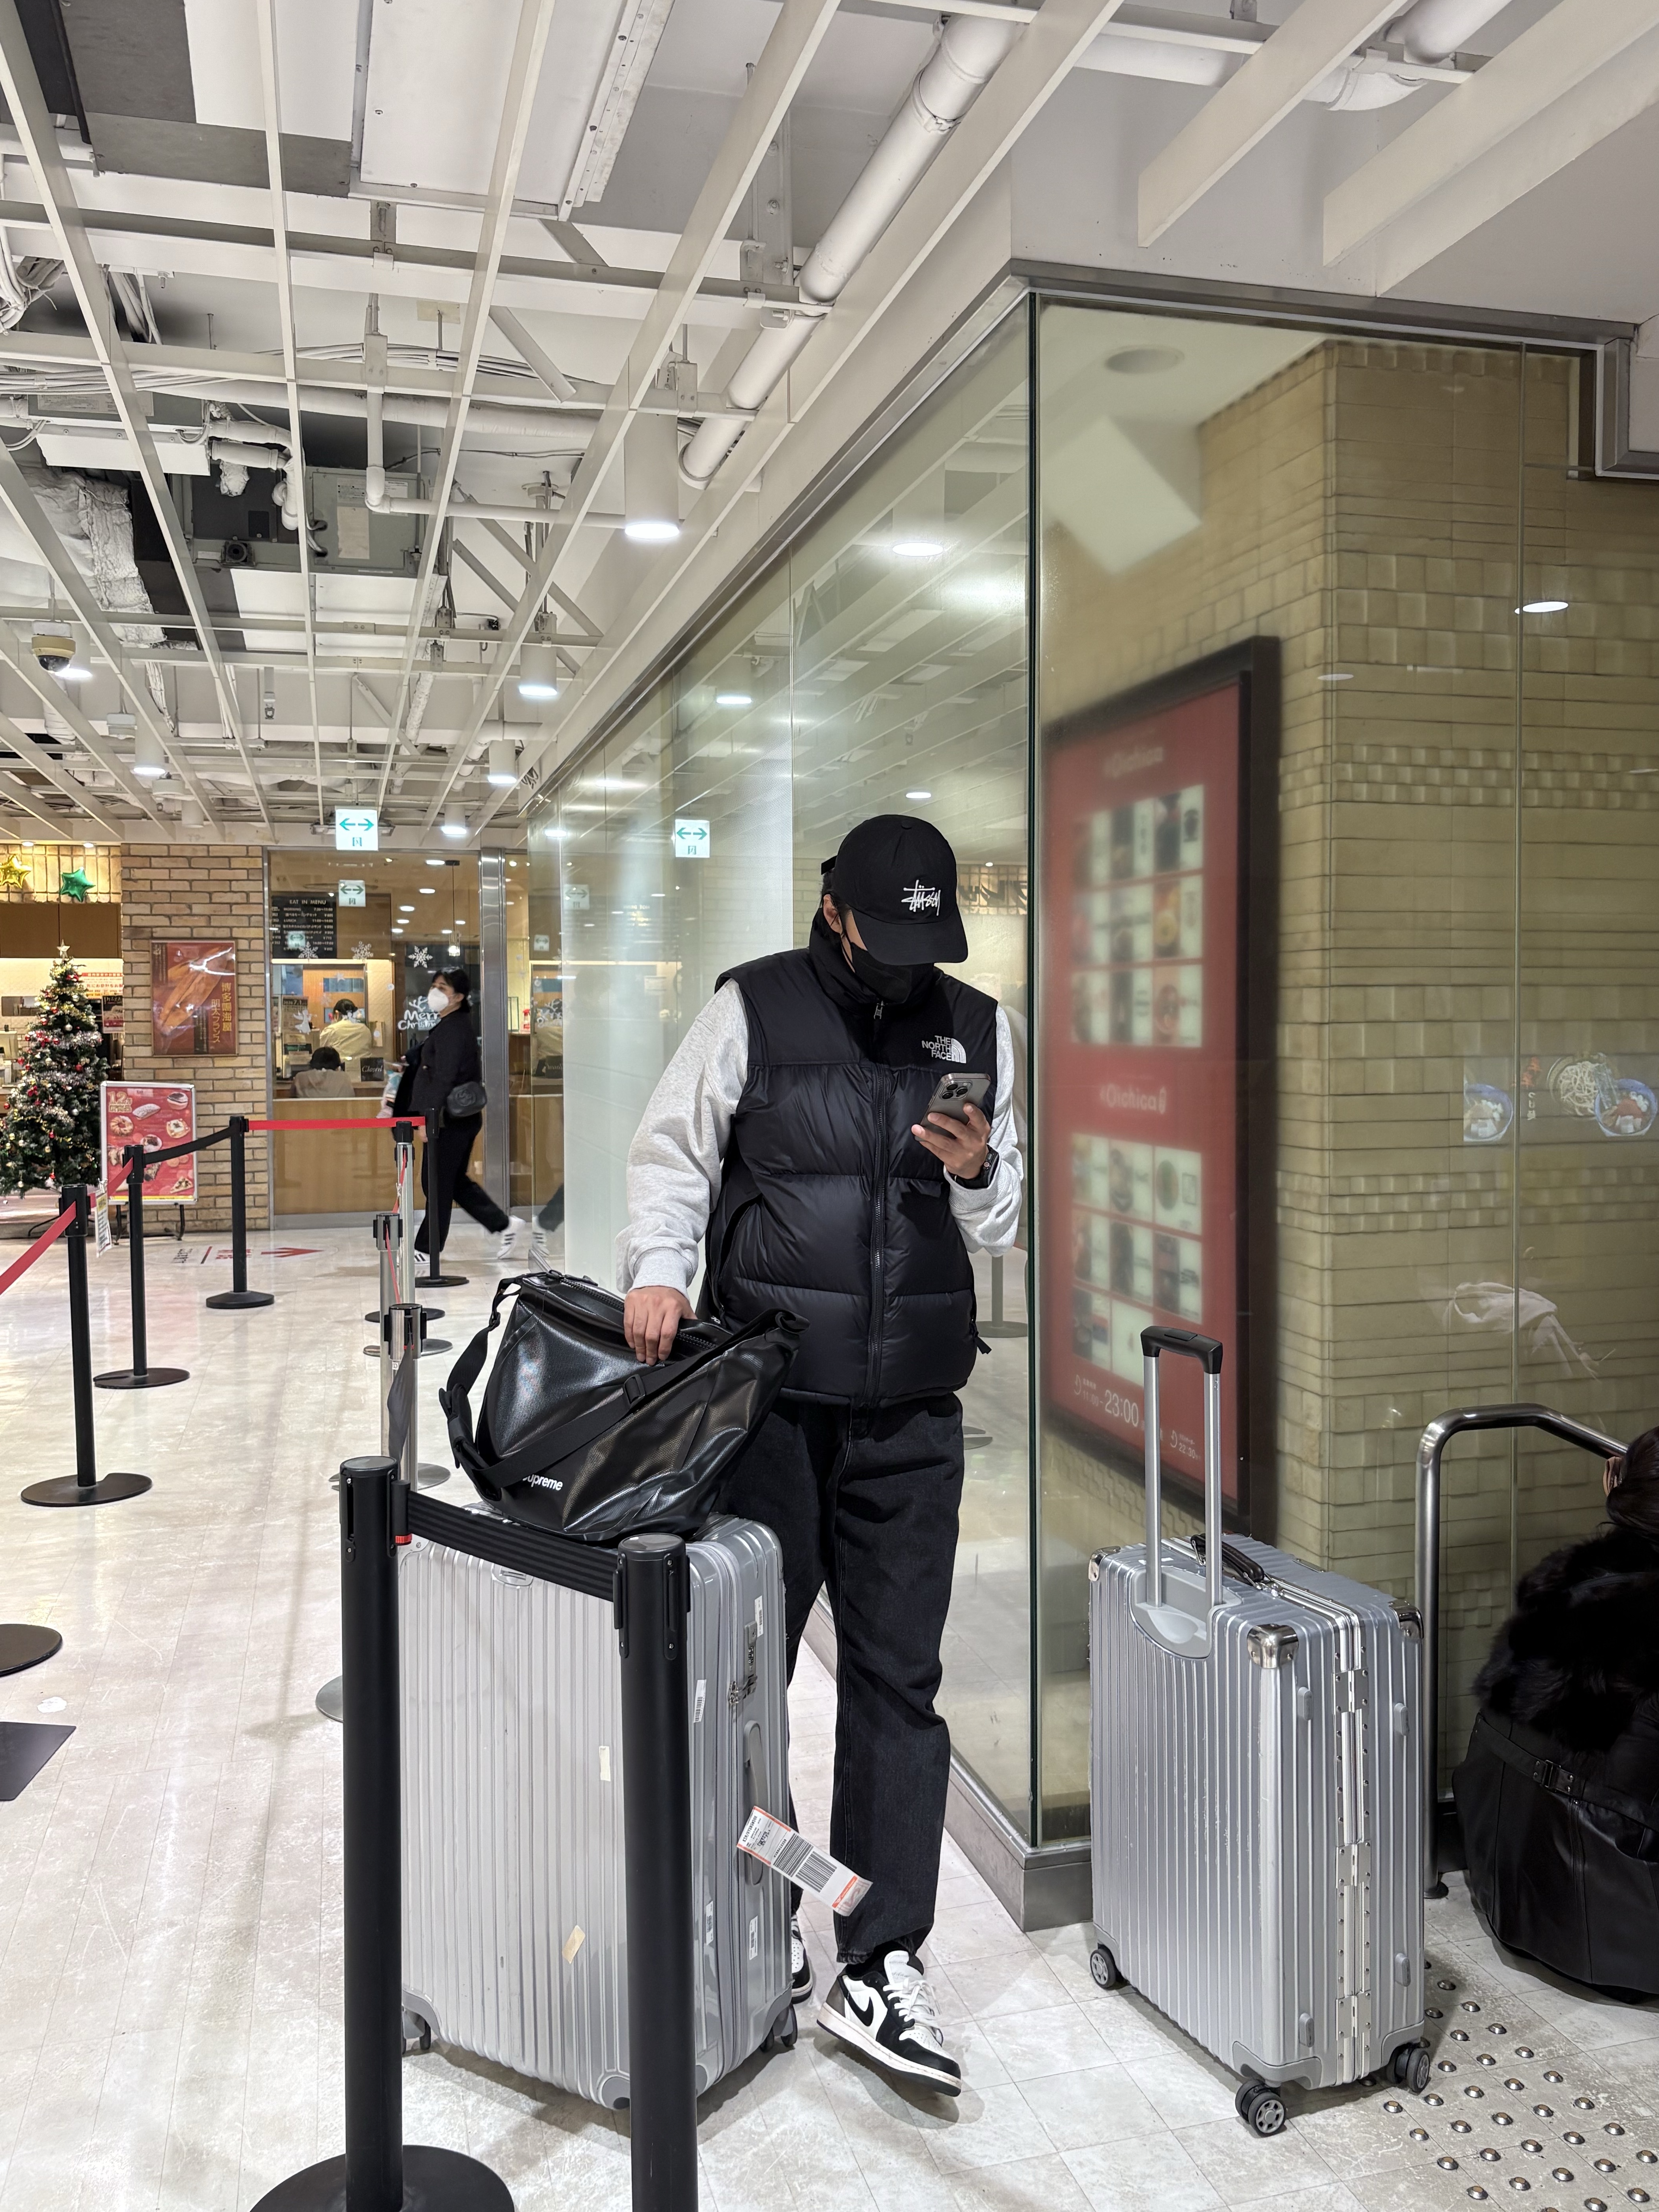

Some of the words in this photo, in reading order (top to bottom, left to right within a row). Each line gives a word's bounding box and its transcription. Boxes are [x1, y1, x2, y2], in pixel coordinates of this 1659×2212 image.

[211, 999, 220, 1043] 明太フランス
[921, 1040, 951, 1053] NORTH
[934, 1035, 951, 1045] THE
[931, 1049, 952, 1061] FACE
[1105, 1389, 1139, 1427] 23:00
[1179, 1442, 1196, 1459] 22:30
[522, 1474, 563, 1491] upreme
